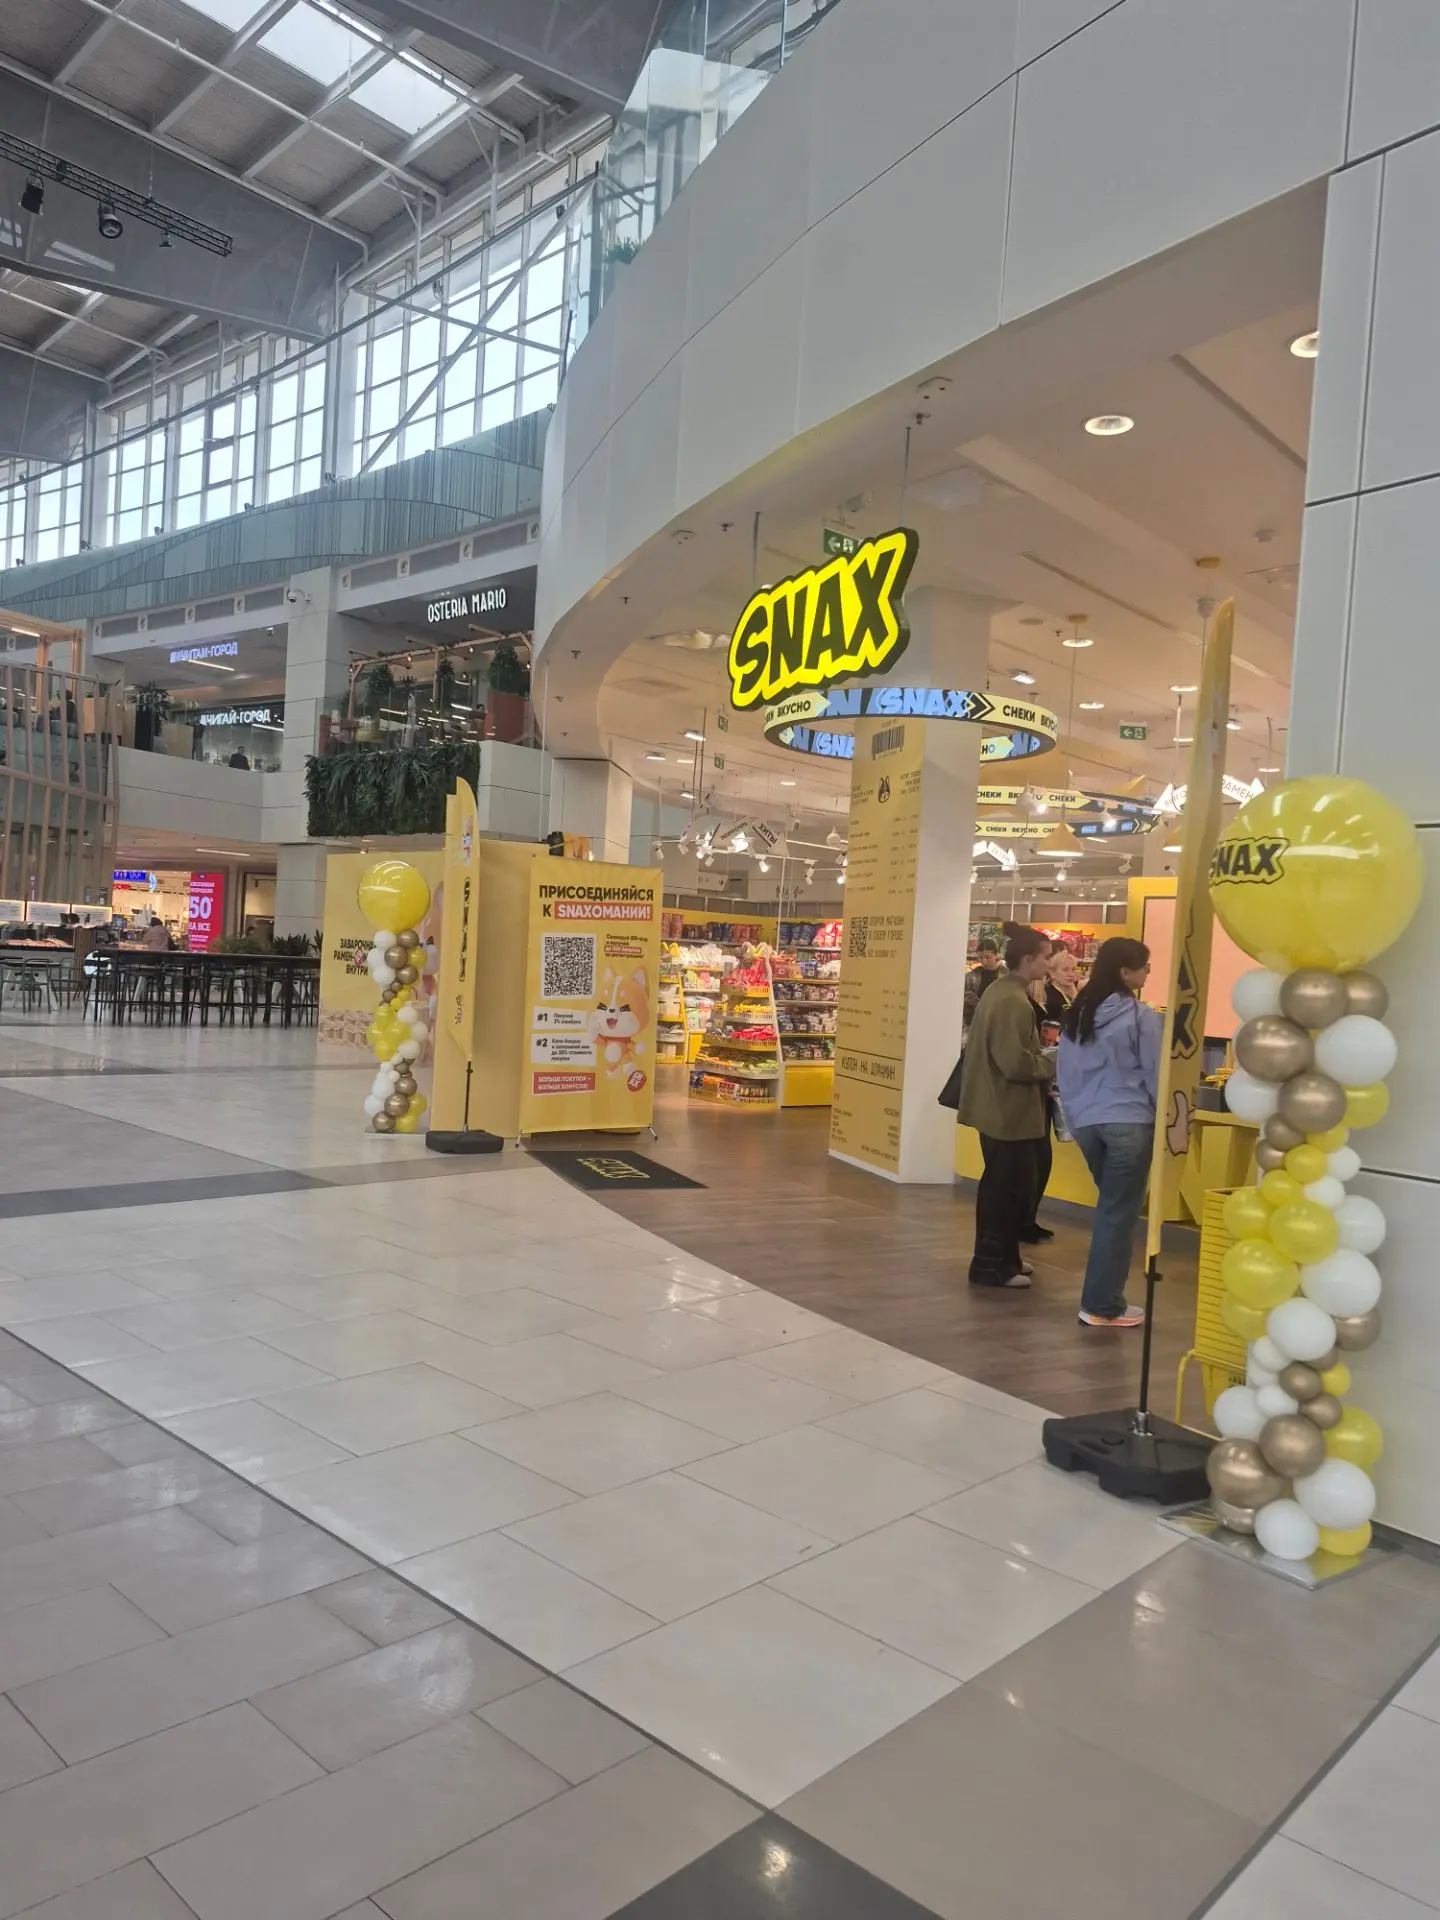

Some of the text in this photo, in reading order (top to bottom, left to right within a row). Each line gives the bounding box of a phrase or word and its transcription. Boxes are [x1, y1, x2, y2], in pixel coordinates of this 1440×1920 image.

[427, 588, 507, 624] OSTERIA MARIO
[733, 545, 899, 695] SNAX
[777, 699, 811, 718] ВКУСНО
[1002, 705, 1036, 723] СНЕКИ
[1049, 794, 1076, 803] СНЕКИ
[757, 822, 779, 845] ХИТЫ
[538, 884, 655, 901] ПРИСОЕДИНЯЙСЯ
[542, 904, 651, 919] К SNAXОМАНИИ!
[340, 938, 377, 950] ЗАВАРОЧН
[346, 964, 369, 976] ВНУТРИ
[537, 1013, 548, 1022] #1
[536, 1038, 548, 1048] #2
